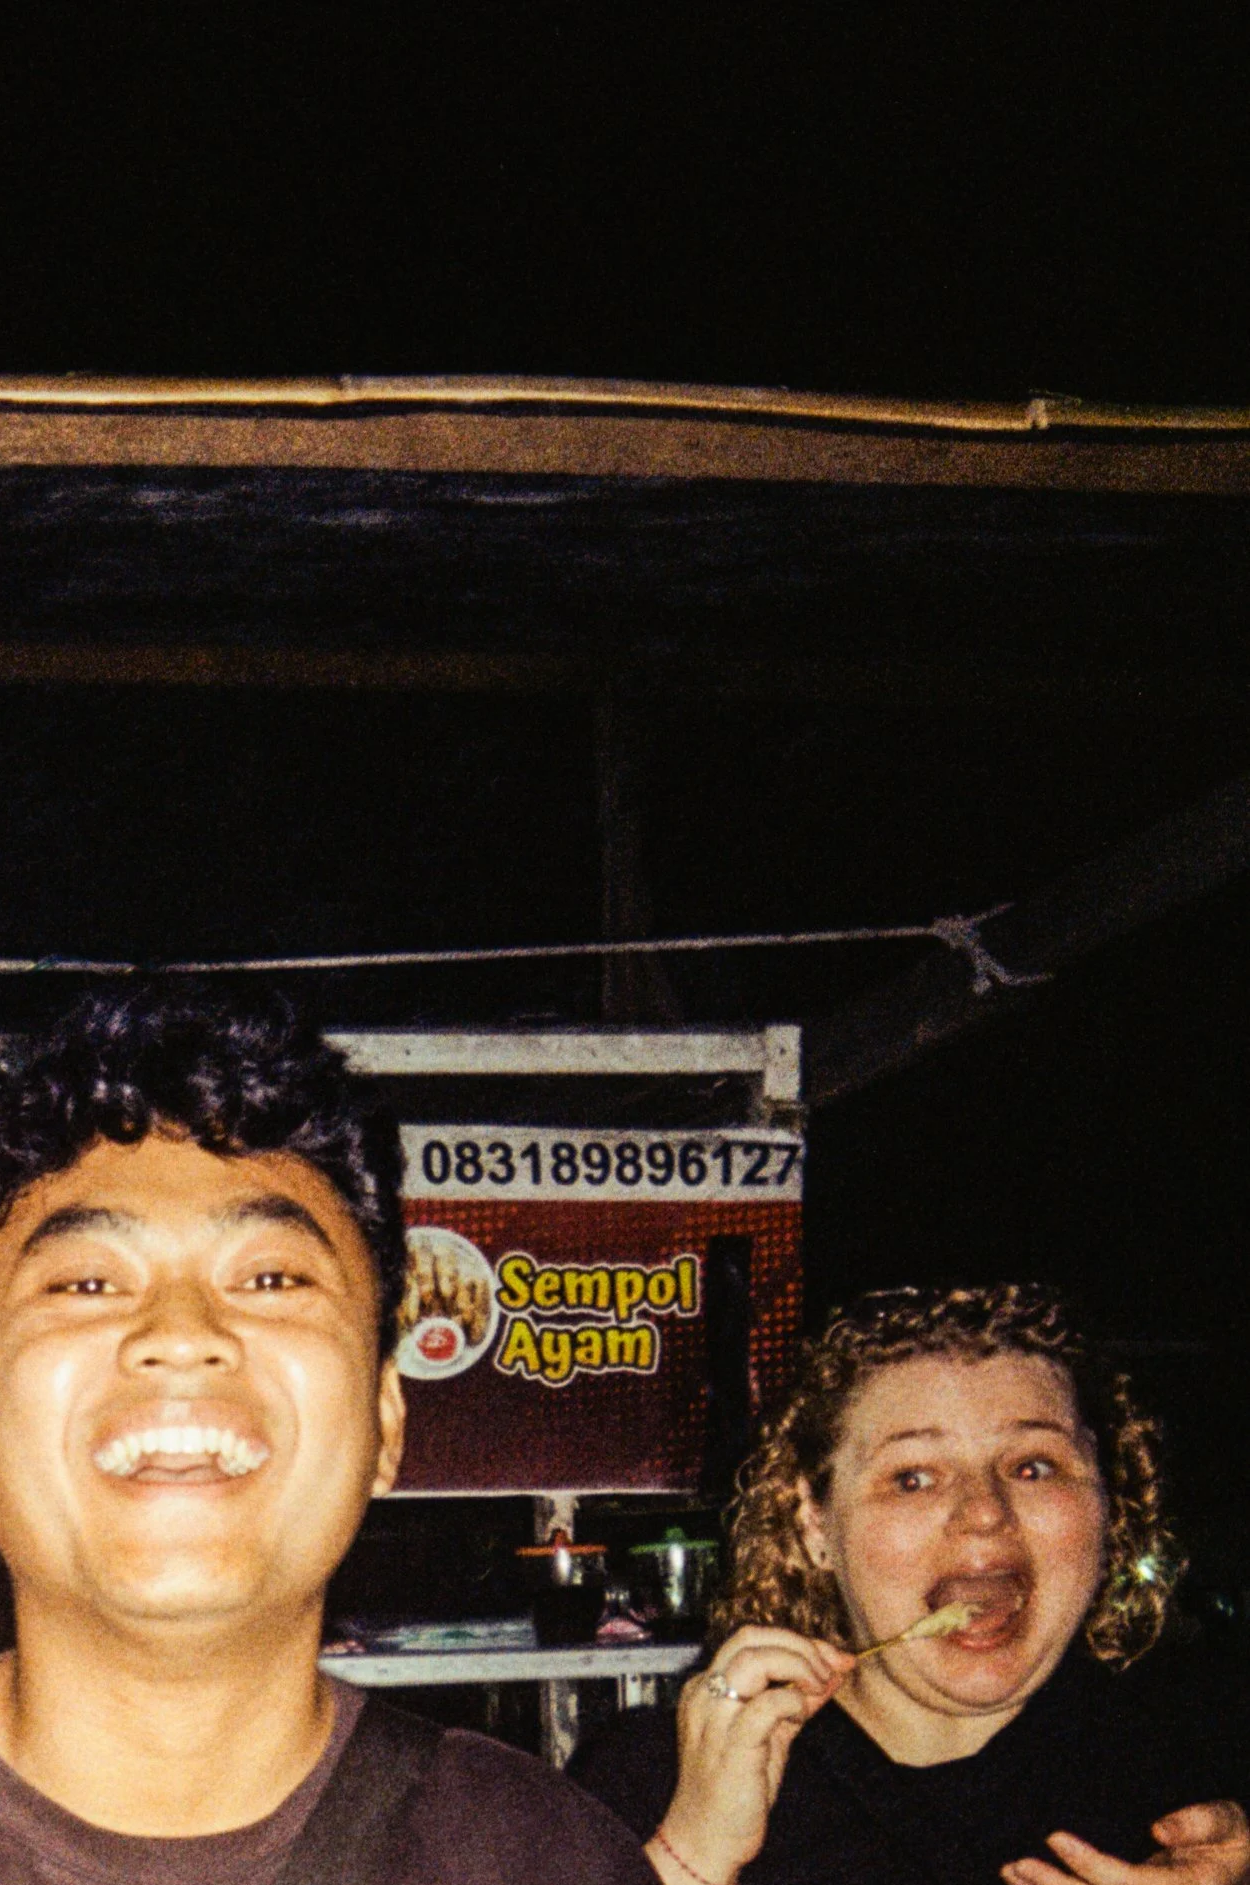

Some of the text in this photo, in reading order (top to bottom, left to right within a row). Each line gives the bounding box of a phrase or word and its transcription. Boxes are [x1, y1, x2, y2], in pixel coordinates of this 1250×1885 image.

[422, 1140, 800, 1187] 083189896127
[497, 1255, 698, 1321] Sempol
[499, 1318, 658, 1382] Ayam
